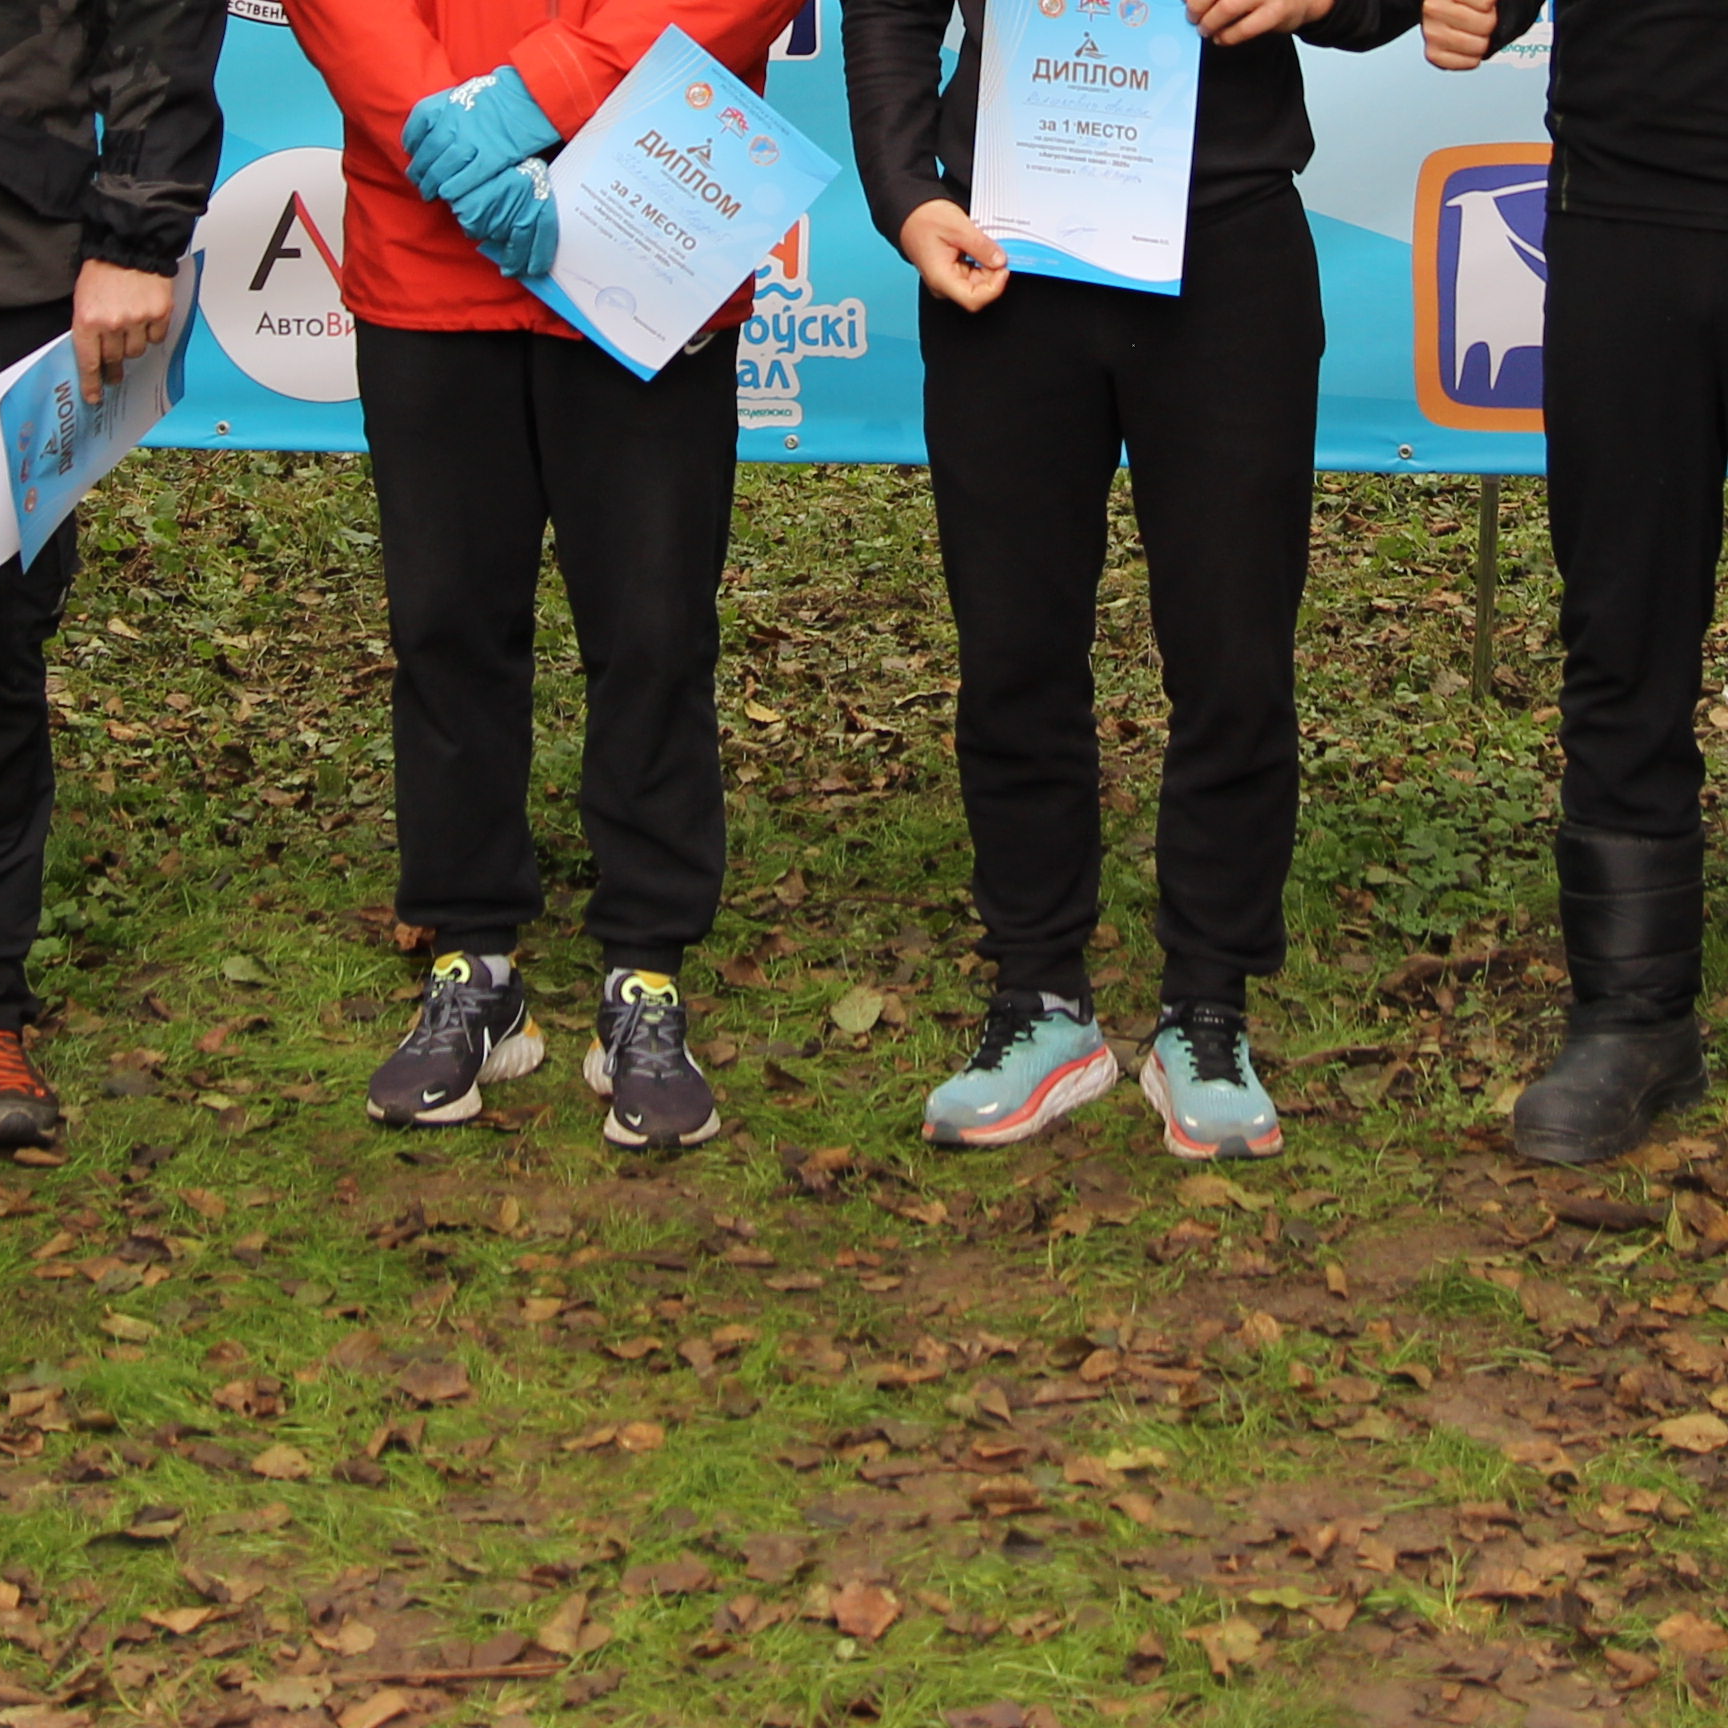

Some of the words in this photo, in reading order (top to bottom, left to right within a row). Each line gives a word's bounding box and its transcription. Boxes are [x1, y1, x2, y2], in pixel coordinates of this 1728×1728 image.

[1032, 58, 1150, 92] ДИПЛОМ
[1038, 119, 1057, 132] за
[1062, 119, 1070, 133] 1
[1075, 120, 1138, 141] МЕСТО
[634, 129, 742, 221] ДИПЛОМ
[610, 179, 629, 198] за
[629, 193, 644, 207] 2
[641, 203, 697, 252] МЕСТО
[255, 311, 357, 337] АвтоВи
[53, 380, 75, 476] ДИПЛОМ
